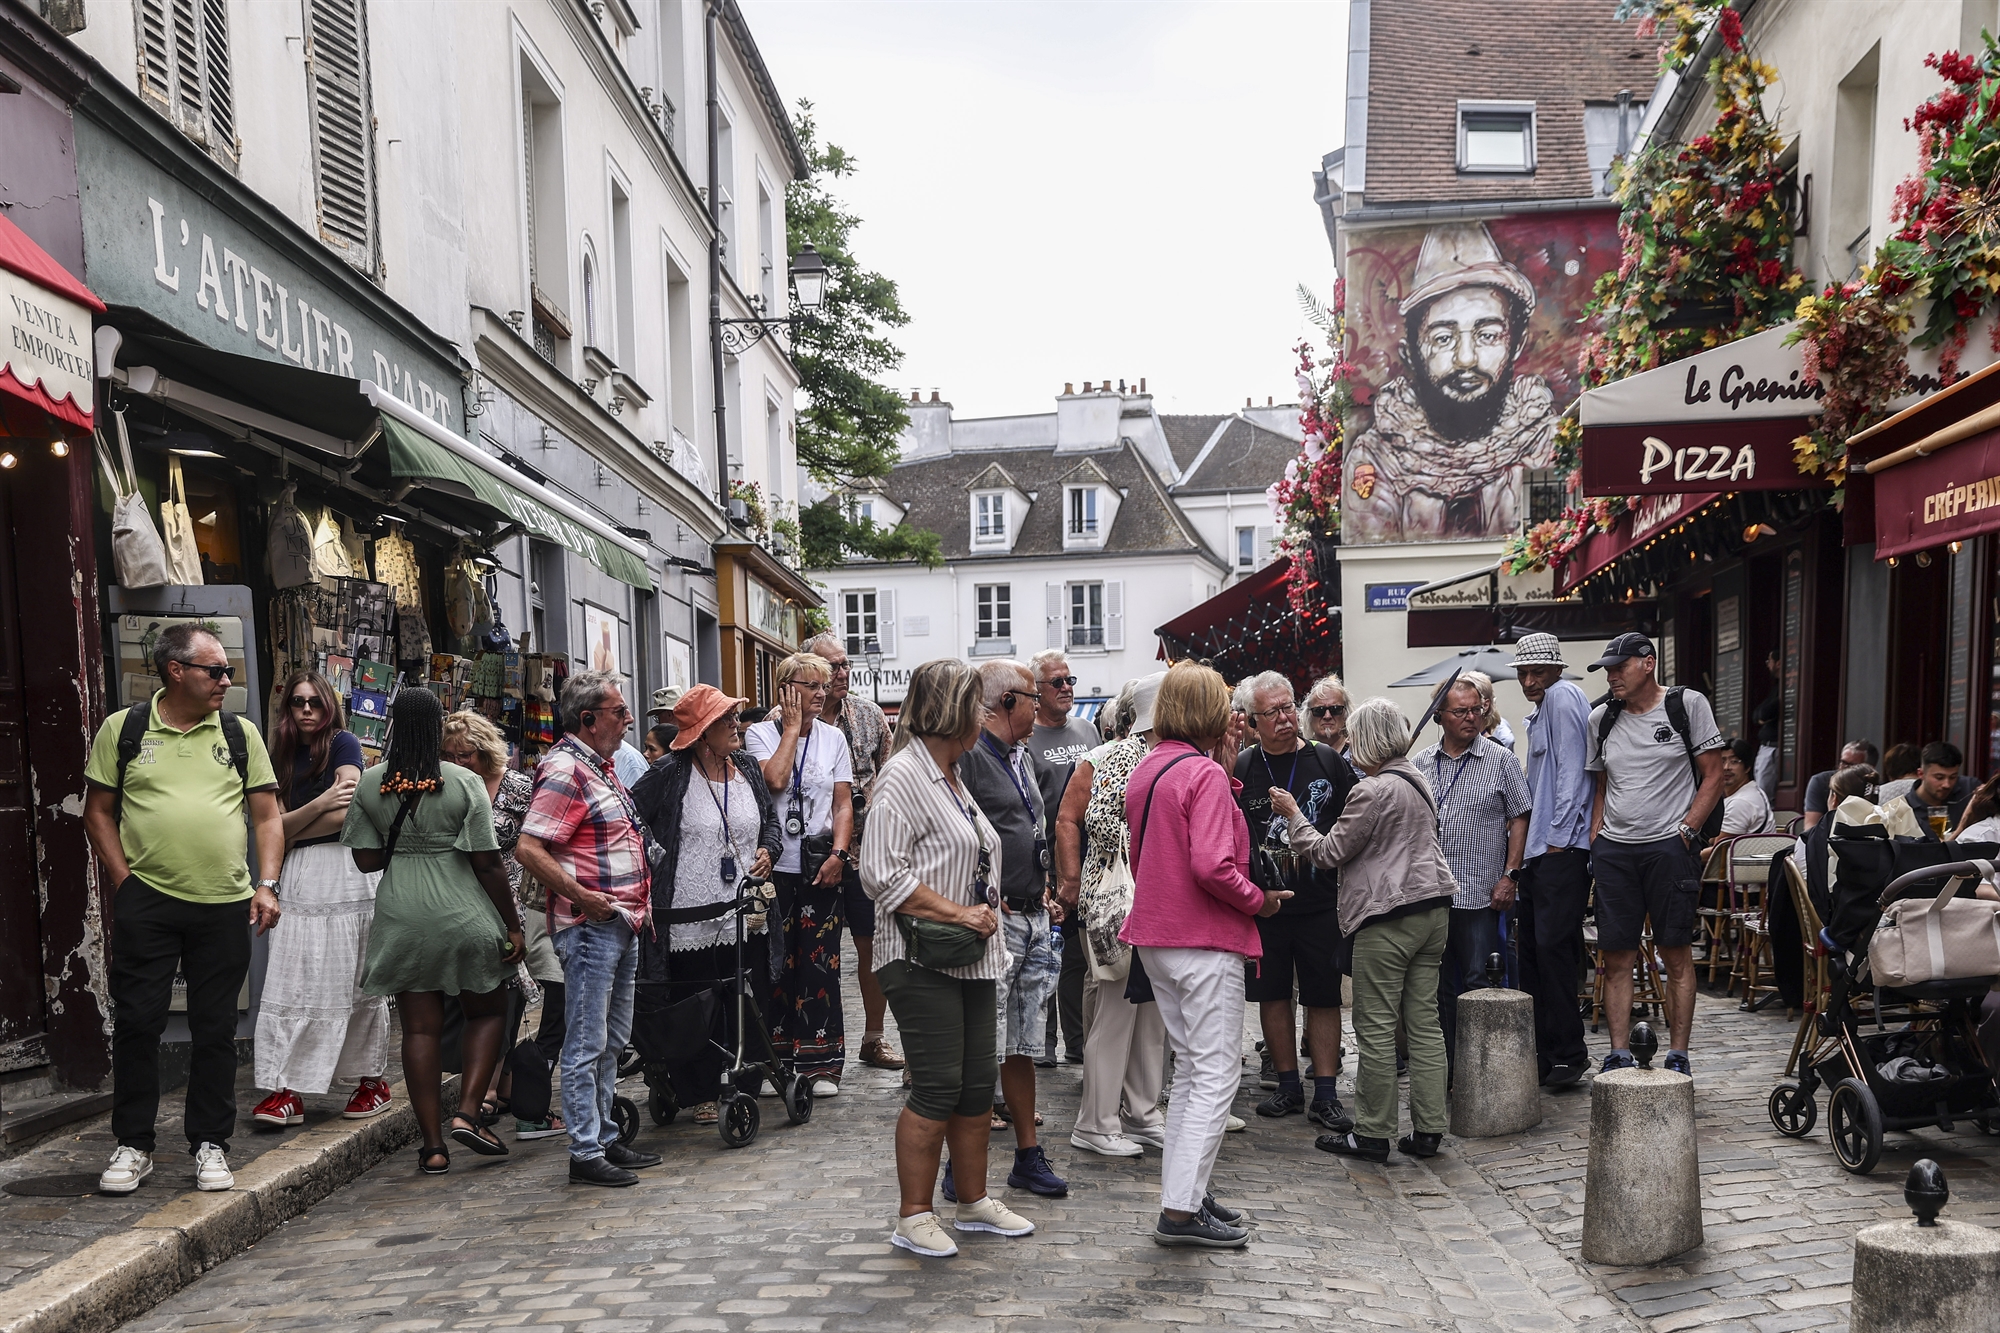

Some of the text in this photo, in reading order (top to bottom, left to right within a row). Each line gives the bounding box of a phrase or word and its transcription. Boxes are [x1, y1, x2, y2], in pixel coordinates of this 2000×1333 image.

[147, 196, 356, 380] L'ATELIER
[9, 293, 79, 347] VENTE A
[11, 324, 93, 384] EMPORTER
[1684, 364, 1711, 406] Le
[1638, 435, 1757, 485] PIZZA
[1387, 588, 1407, 597] RUE
[851, 669, 912, 687] MONTMA
[138, 748, 157, 765] 71
[1043, 743, 1089, 758] OLD MAN
[575, 751, 603, 778] adidas
[1248, 797, 1272, 807] SINGA
